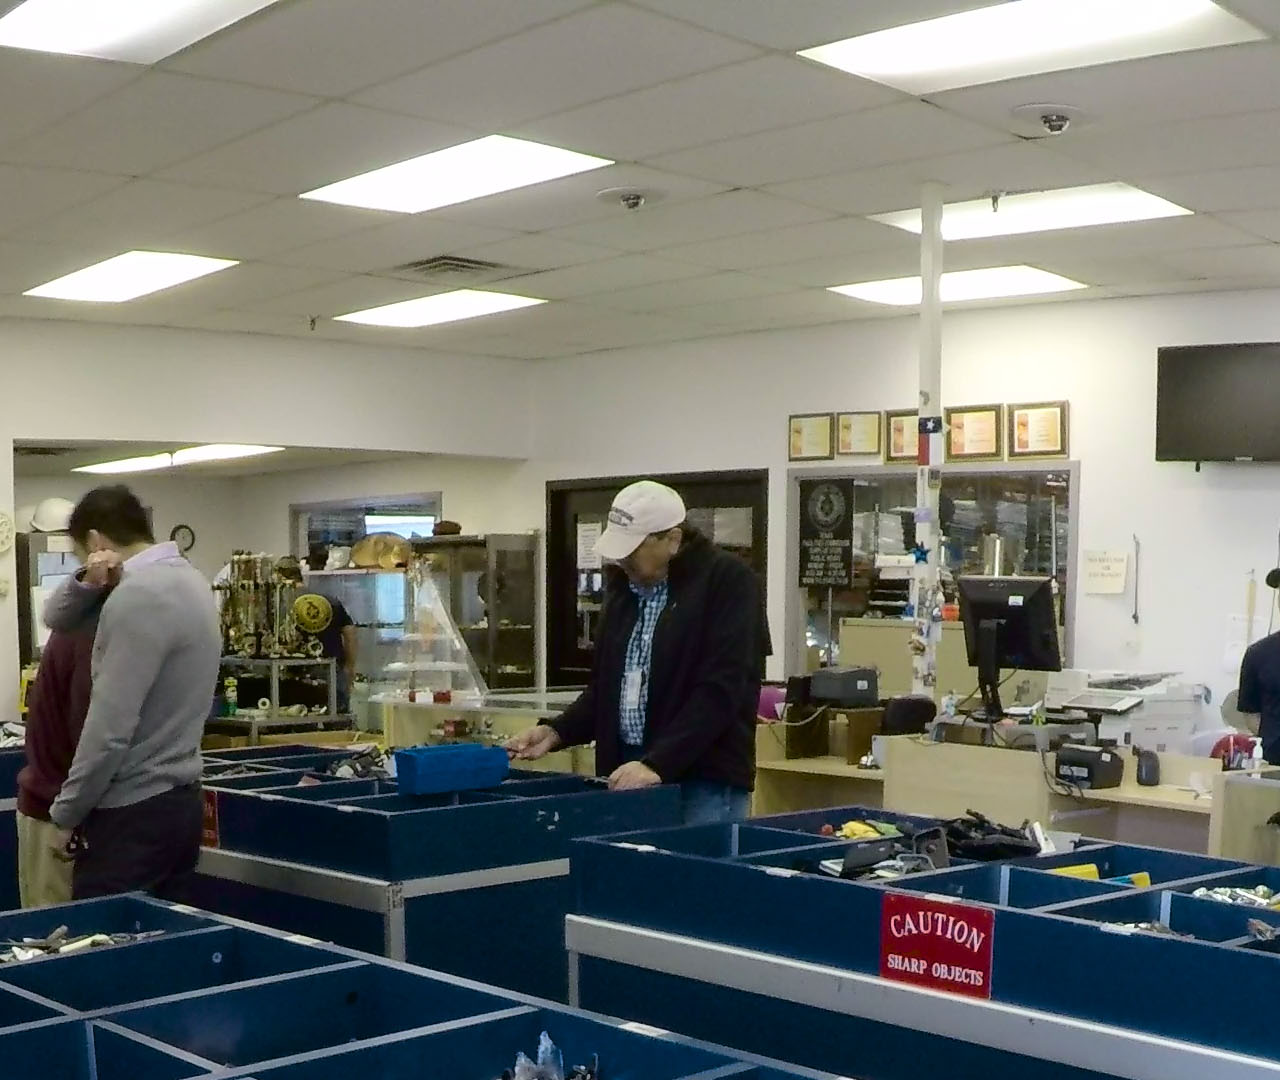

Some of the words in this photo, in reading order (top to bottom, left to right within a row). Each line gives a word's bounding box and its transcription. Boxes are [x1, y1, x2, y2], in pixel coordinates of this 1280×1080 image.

[890, 911, 986, 953] CAUTION
[887, 953, 928, 975] SHARP
[932, 962, 984, 986] OBJECTS
